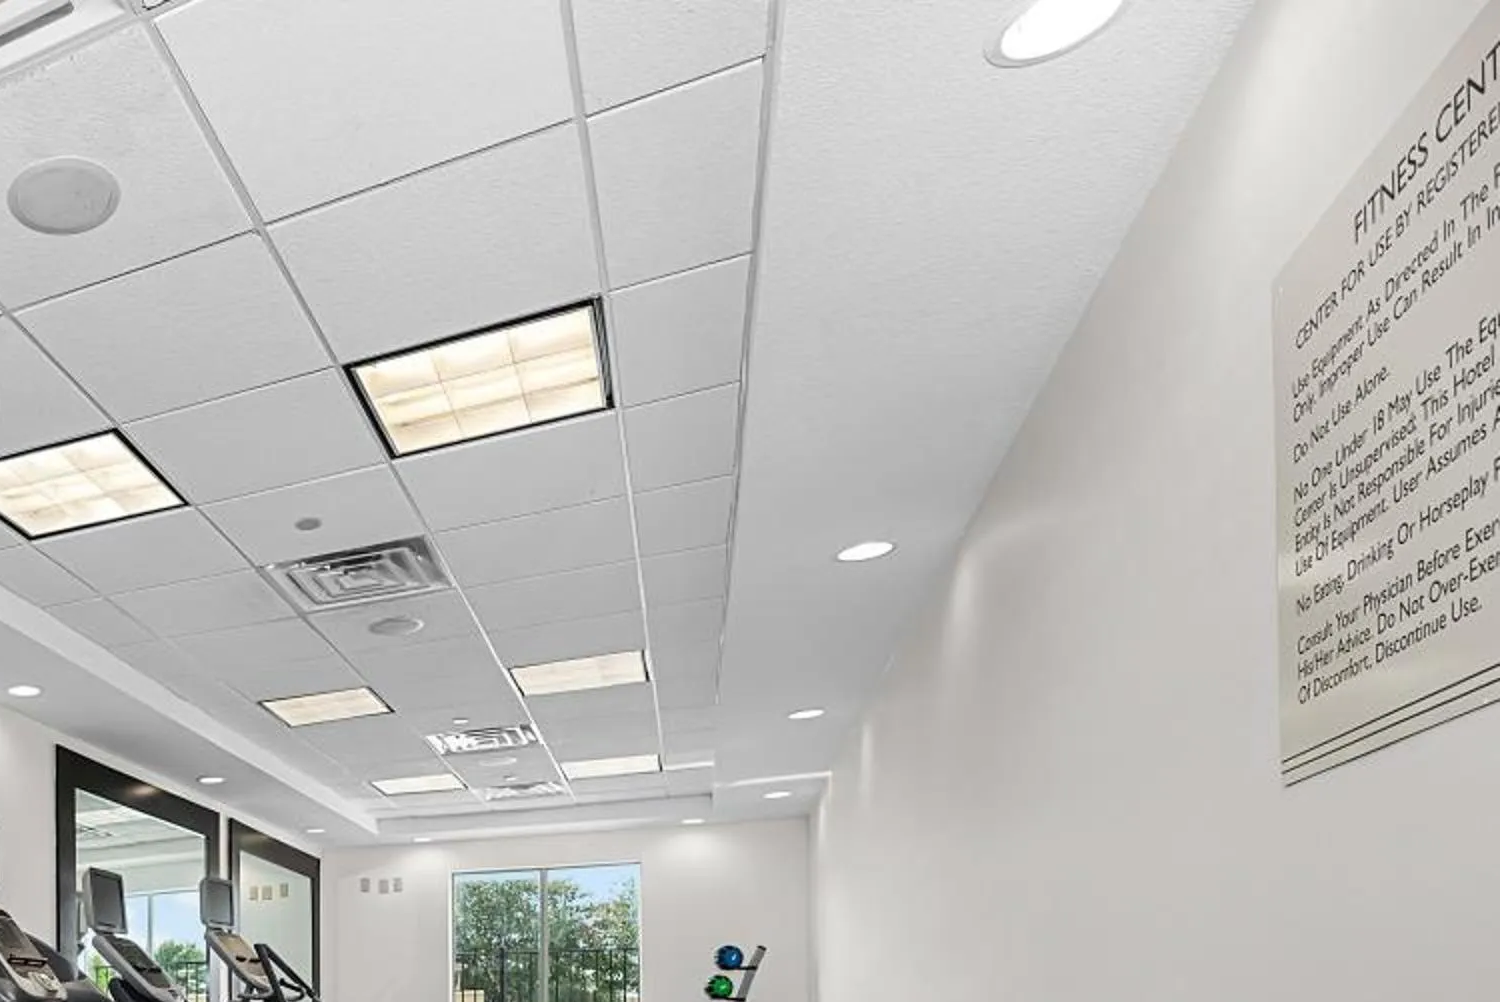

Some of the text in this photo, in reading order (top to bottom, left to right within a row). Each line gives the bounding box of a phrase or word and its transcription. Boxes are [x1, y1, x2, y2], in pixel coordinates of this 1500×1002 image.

[1295, 101, 1500, 349] CENTER FOR USE BY REGISTERE
[1354, 131, 1428, 245] FITNESS
[1292, 373, 1310, 399] Use
[1311, 315, 1363, 378] Equipment
[1366, 297, 1381, 323] As
[1385, 229, 1439, 302] Directed
[1443, 218, 1455, 243] In
[1460, 184, 1489, 221] The
[1319, 341, 1364, 398] Improper
[1368, 317, 1390, 346] Use
[1393, 288, 1418, 320] Can
[1421, 240, 1463, 293] Result
[1467, 224, 1481, 249] In
[1293, 366, 1390, 464] Do Not Use Alone.
[1293, 481, 1309, 505] No
[1311, 461, 1333, 487] One
[1335, 428, 1368, 467] Under
[1373, 409, 1385, 436] 18
[1387, 389, 1413, 422] May
[1415, 365, 1441, 395] Use
[1445, 337, 1473, 369] The
[1294, 491, 1326, 527] Center
[1329, 481, 1337, 501] Is
[1420, 389, 1449, 421] This
[1453, 343, 1495, 397] Hotel
[1294, 522, 1321, 553] Entity
[1323, 511, 1331, 531] Is
[1333, 494, 1356, 522] Not
[1357, 437, 1425, 501] Responsible
[1429, 416, 1452, 447] For
[1295, 554, 1313, 577] Use
[1315, 535, 1329, 561] Of
[1331, 498, 1389, 551] Equipment.
[1393, 470, 1423, 503] User
[1425, 423, 1487, 481] Assumes
[1296, 593, 1313, 617] No
[1348, 538, 1394, 581] Drinking
[1397, 521, 1416, 545] Or
[1419, 471, 1489, 531] Horseplay
[1298, 620, 1333, 655] Consult
[1335, 606, 1360, 631] Your
[1363, 572, 1413, 616] Physician
[1417, 543, 1461, 582] Before
[1298, 683, 1311, 705] Of
[1375, 612, 1447, 664] Discontinue
[1451, 595, 1483, 623] Use.
[1377, 612, 1395, 635] Do
[1400, 594, 1425, 622] Not
